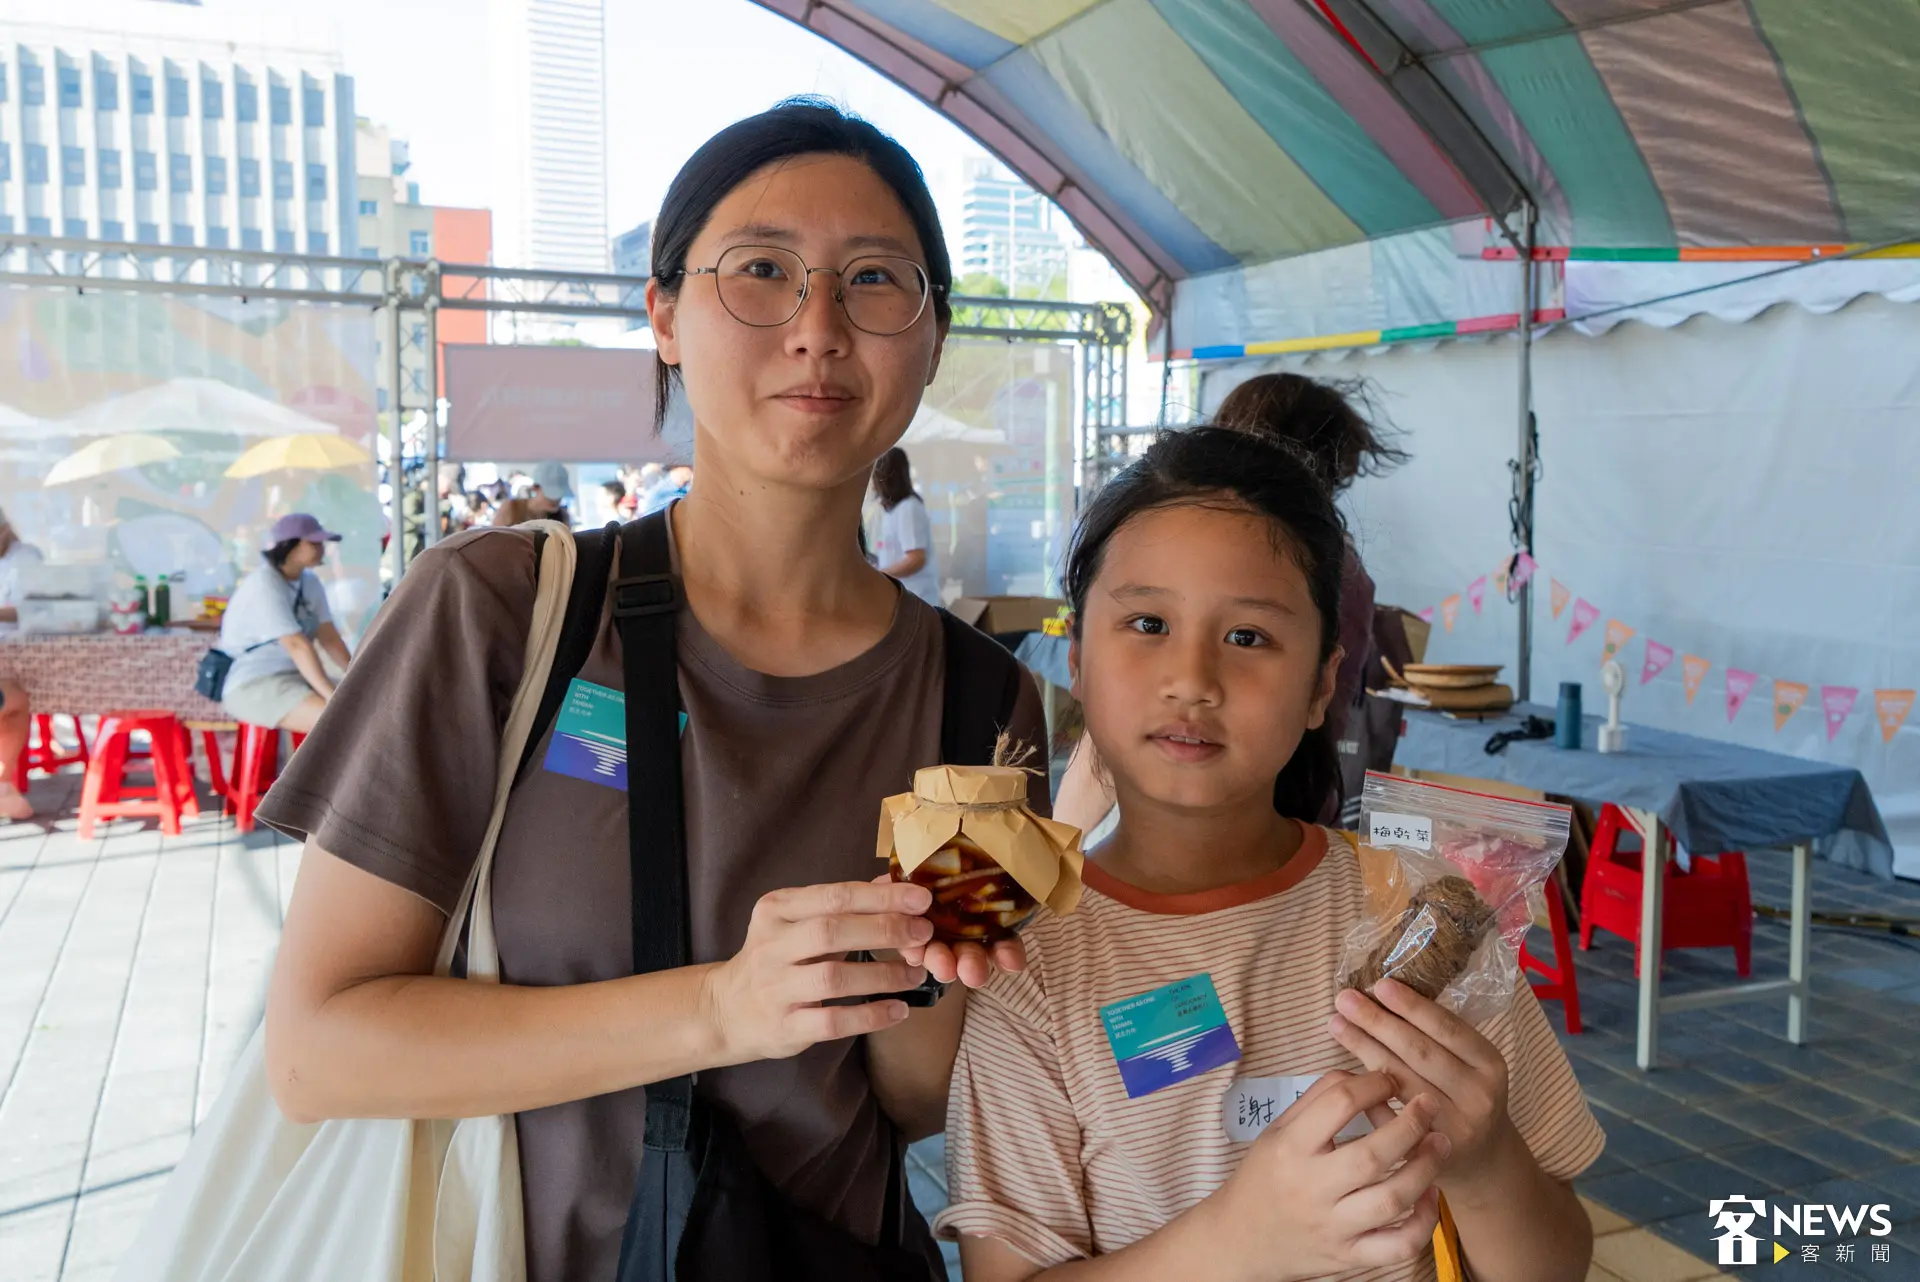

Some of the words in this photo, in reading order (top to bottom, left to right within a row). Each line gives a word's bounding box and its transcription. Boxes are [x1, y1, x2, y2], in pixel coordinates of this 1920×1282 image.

[575, 693, 589, 701] WITH
[1373, 825, 1430, 843] 梅乾菜
[1238, 1092, 1276, 1128] 謝
